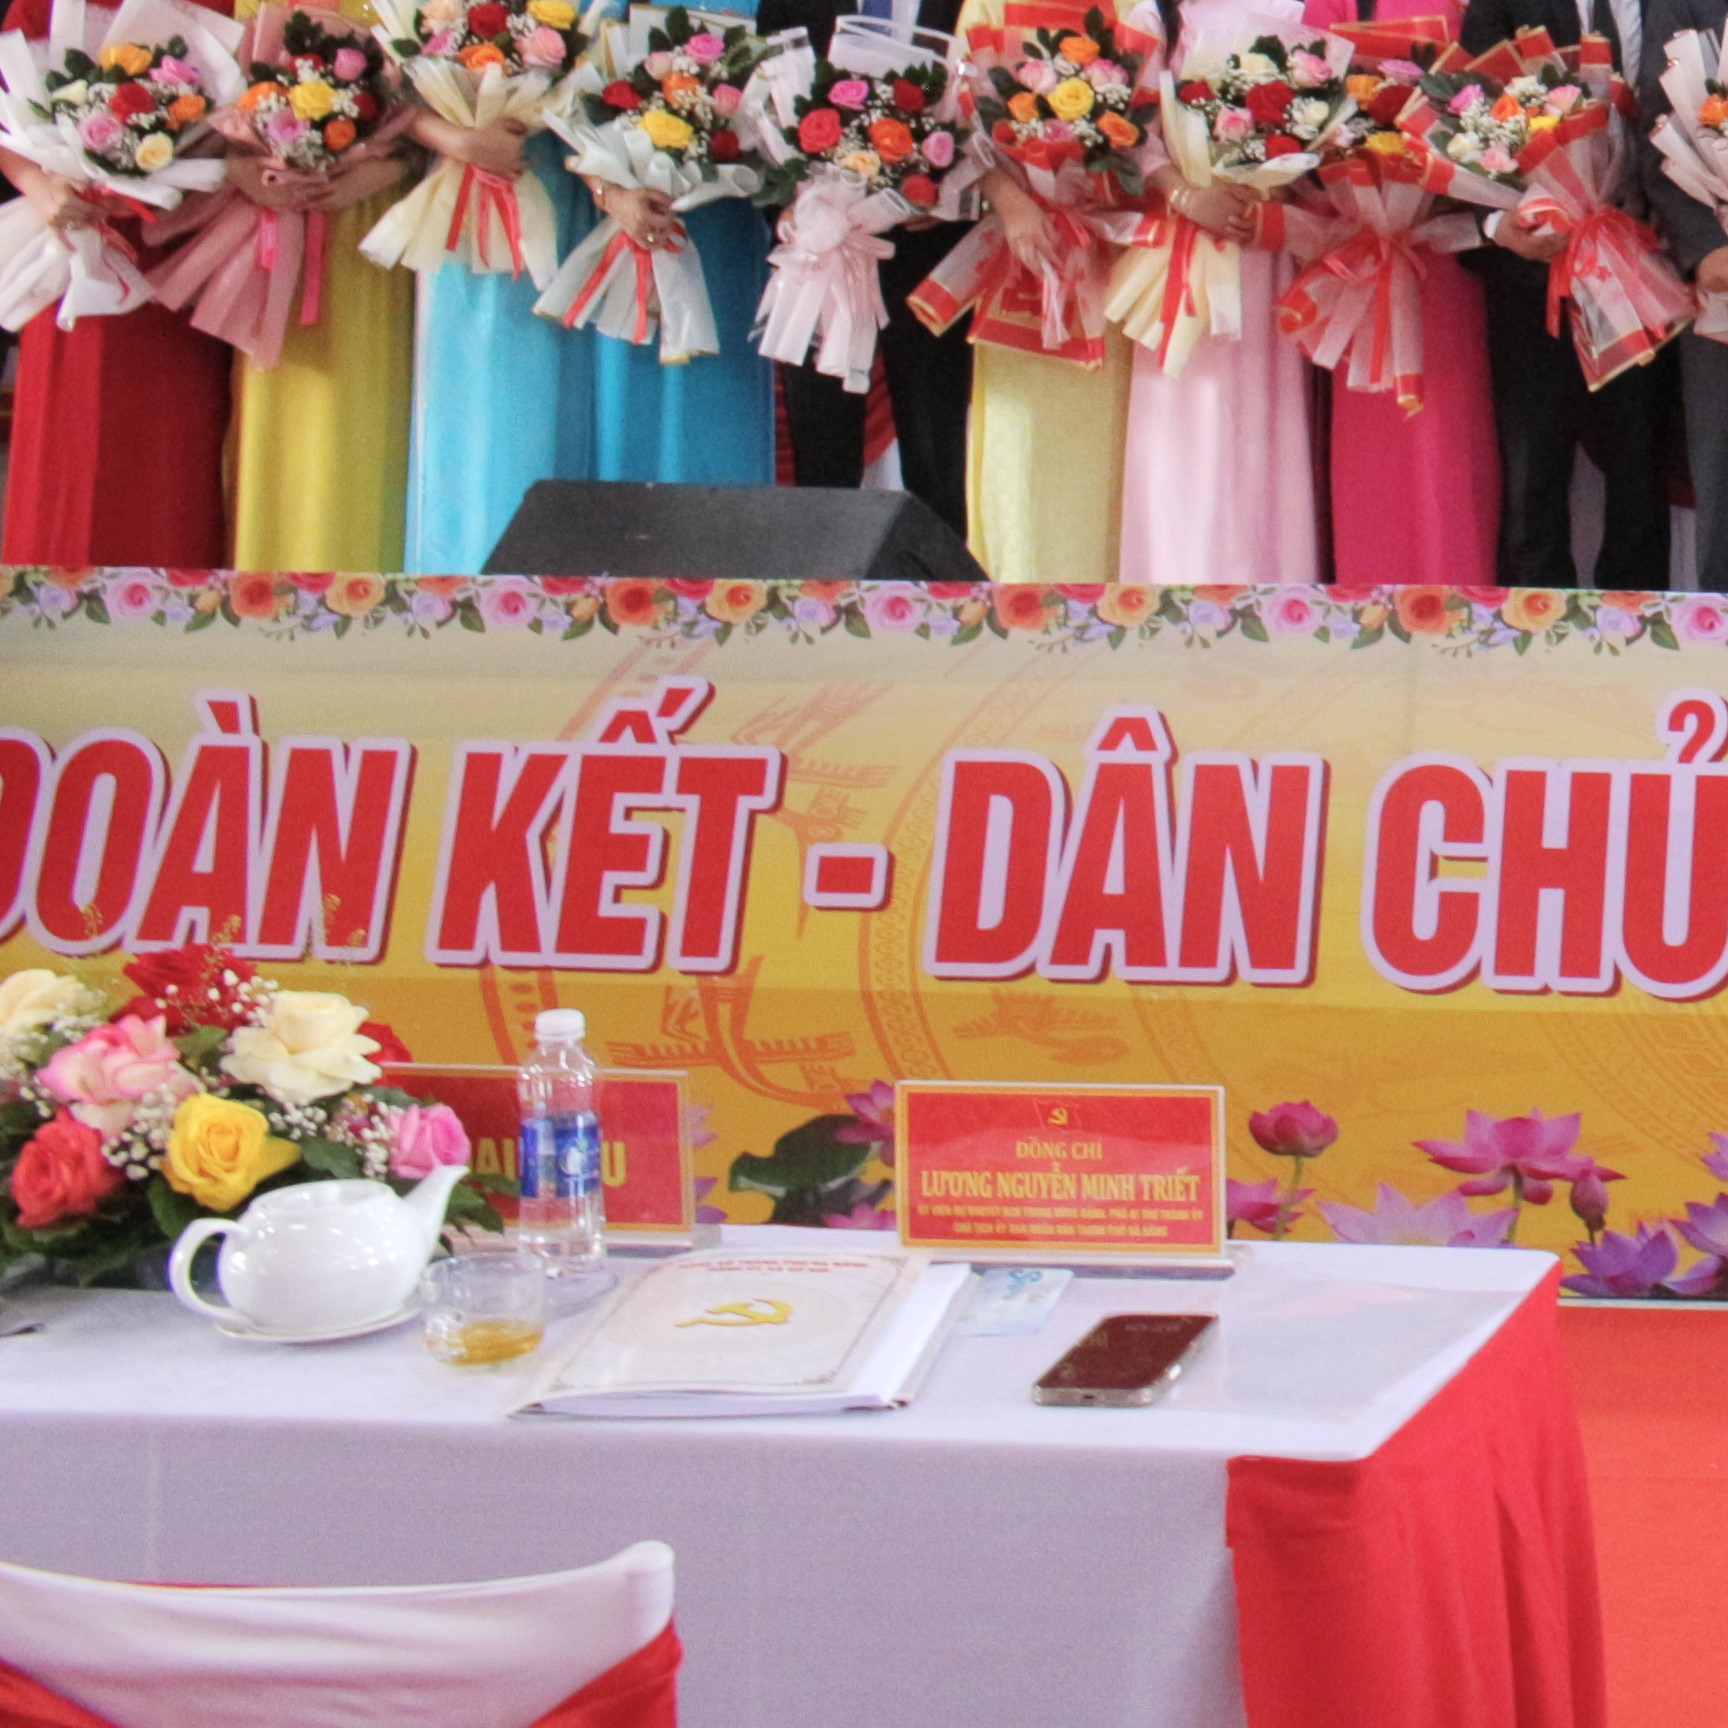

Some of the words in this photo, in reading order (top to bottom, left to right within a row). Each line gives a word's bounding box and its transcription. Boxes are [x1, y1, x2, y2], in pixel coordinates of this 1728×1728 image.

[427, 676, 783, 971] KẾT
[803, 840, 890, 908] -
[926, 704, 1327, 983] DÂN
[920, 1169, 994, 1199] LƯƠNG
[1081, 1173, 1136, 1202] MINH
